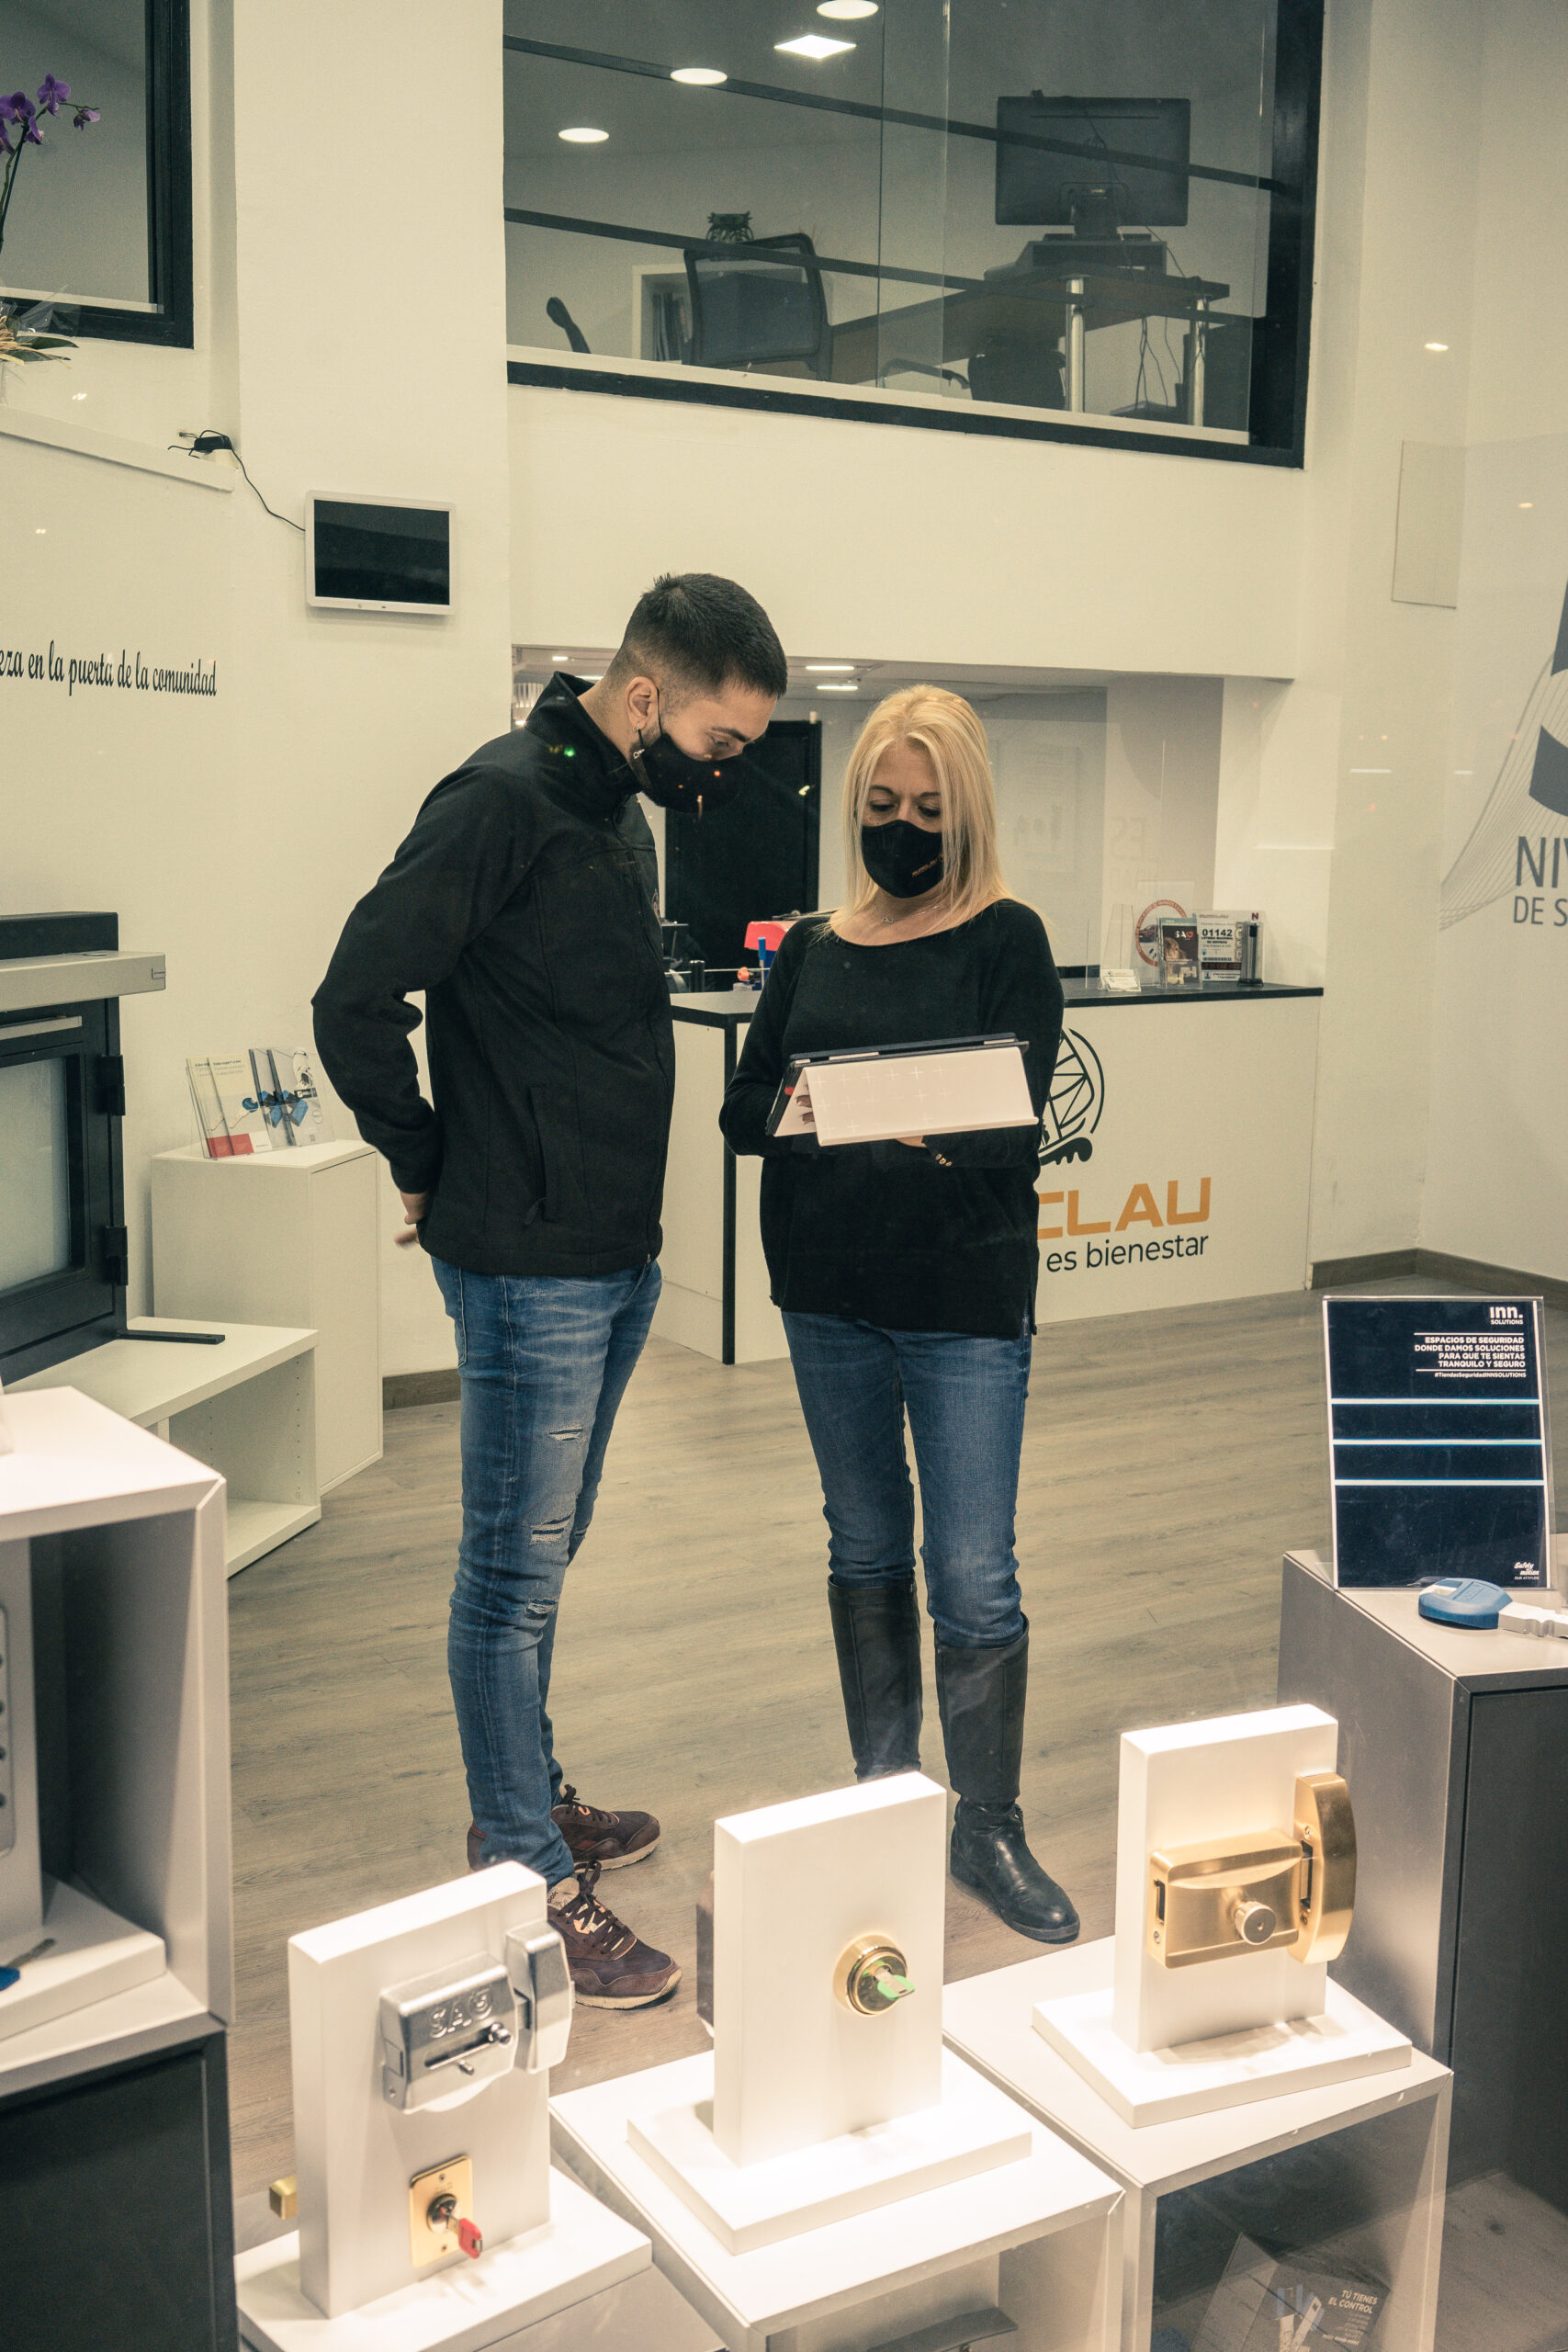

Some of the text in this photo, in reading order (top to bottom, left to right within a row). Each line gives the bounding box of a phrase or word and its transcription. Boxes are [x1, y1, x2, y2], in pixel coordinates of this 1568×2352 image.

[28, 653, 45, 680] en
[49, 639, 65, 682] la
[68, 652, 114, 696] puerta
[118, 649, 133, 689] de
[135, 650, 150, 691] la
[152, 658, 217, 696] comunidad
[1516, 835, 1568, 888] NI
[1514, 895, 1545, 925] DE
[1201, 928, 1233, 937] 01142
[1046, 1235, 1209, 1272] es bienestar
[1425, 1336, 1525, 1344] ESPACIOS DE SEGURIDAD
[1474, 1344, 1525, 1352] SOLUCIONES
[1438, 1360, 1526, 1368] TRANQUILO Y SEGURO
[1341, 2289, 1379, 2305] TÚ TIENES
[1328, 2297, 1373, 2314] EL CONTROL
